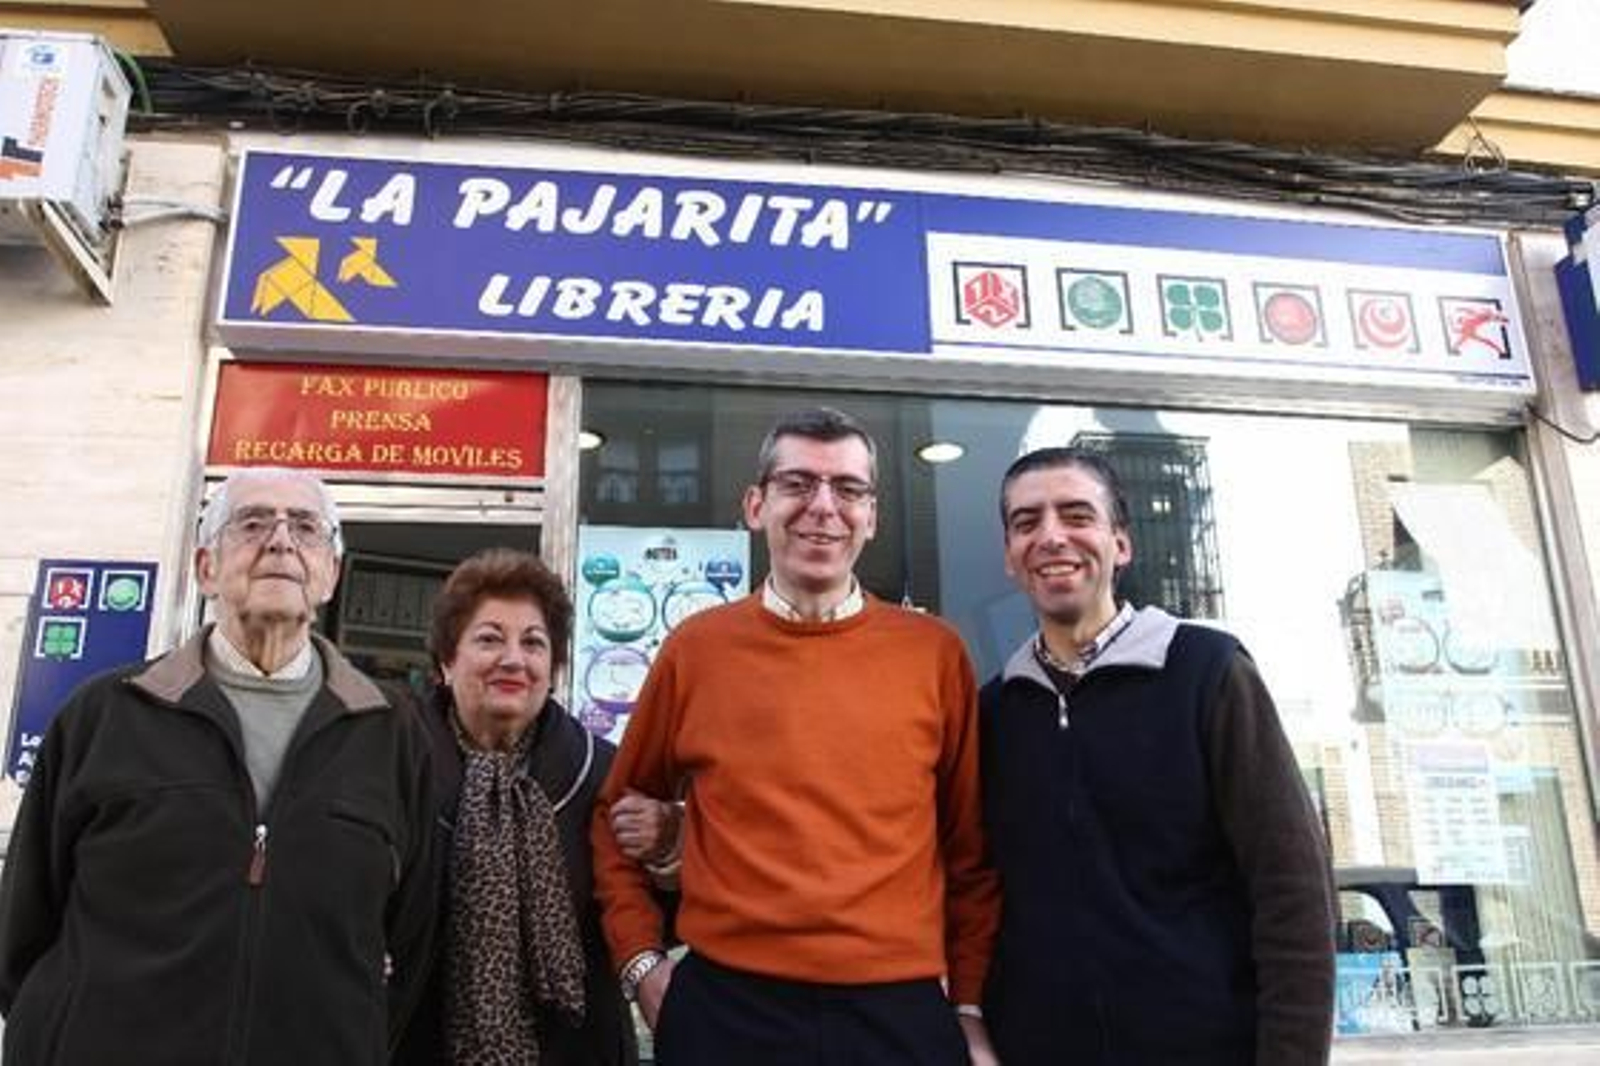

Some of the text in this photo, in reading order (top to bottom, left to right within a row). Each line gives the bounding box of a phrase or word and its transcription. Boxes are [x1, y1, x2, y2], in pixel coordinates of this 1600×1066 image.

[478, 275, 824, 333] LIBRERIA
[300, 375, 469, 401] FAX PUBLICO
[330, 409, 432, 432] PRENSA
[234, 438, 523, 470] RECARGA DE MOVILES
[21, 732, 44, 747] Lo
